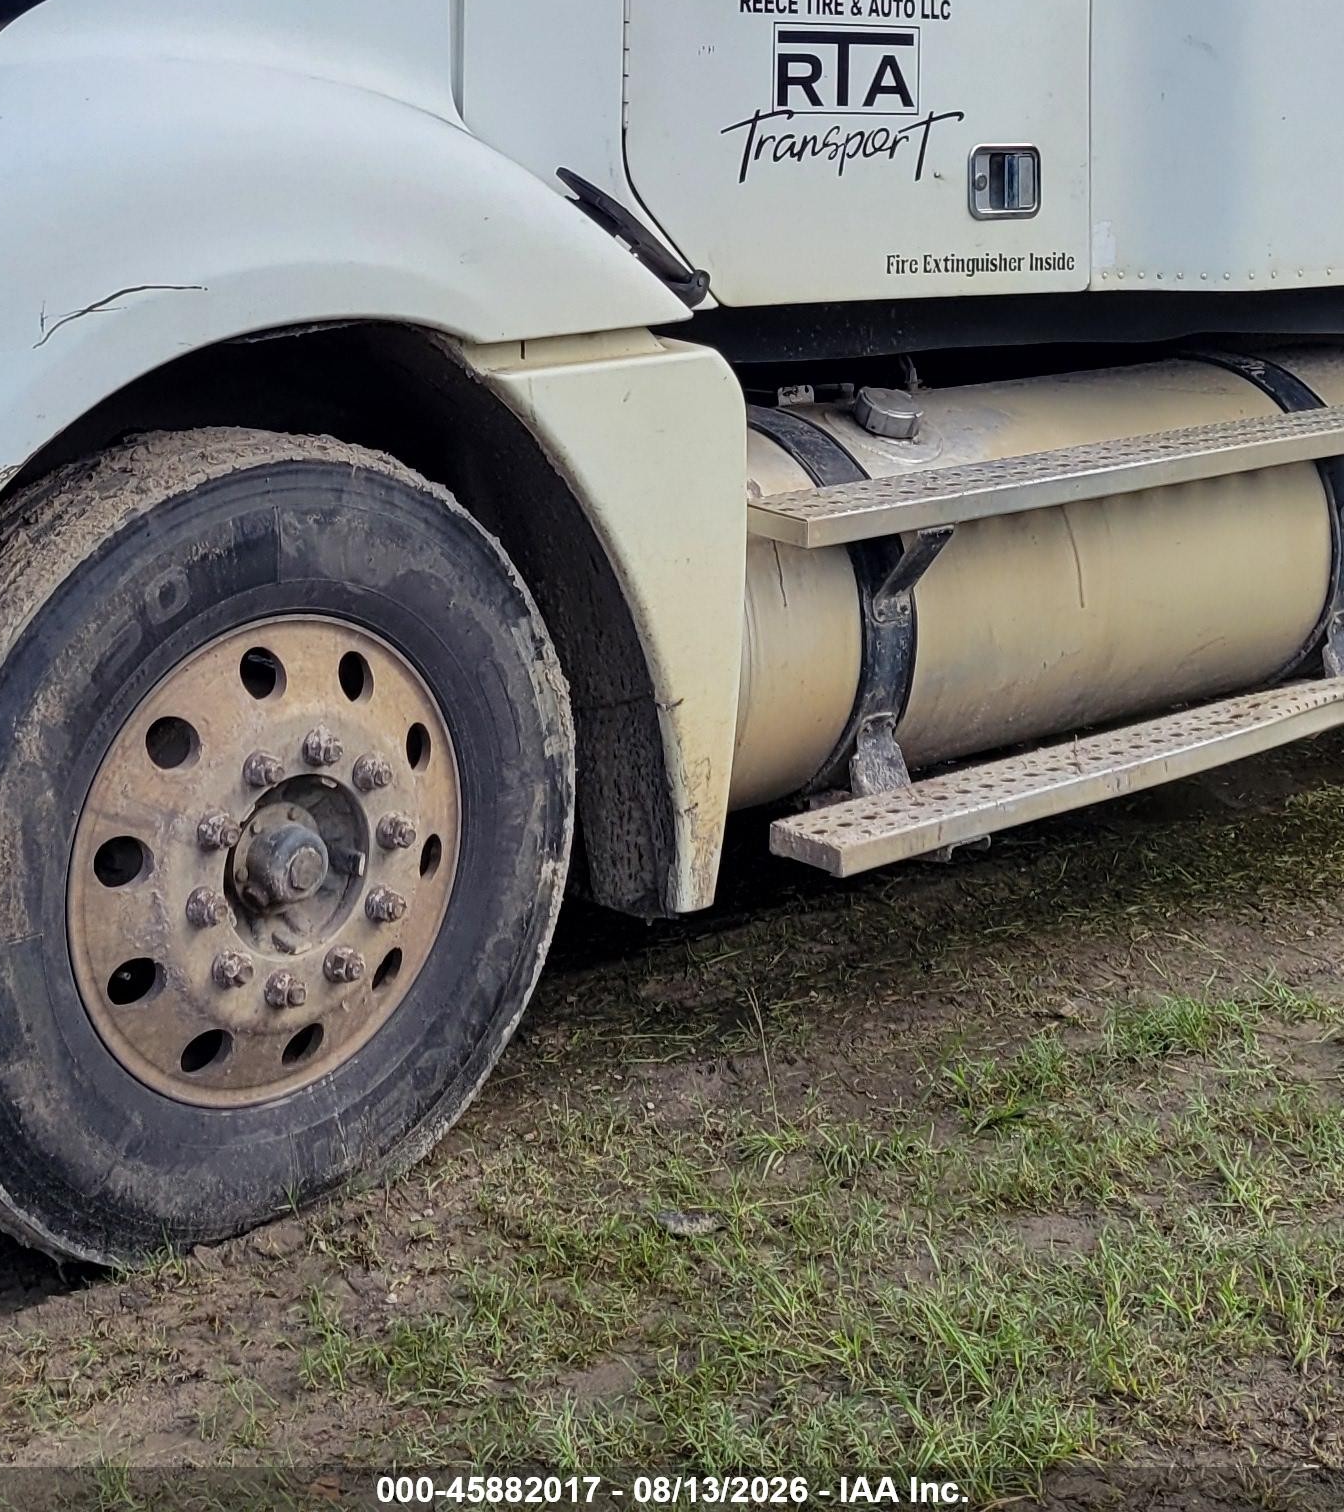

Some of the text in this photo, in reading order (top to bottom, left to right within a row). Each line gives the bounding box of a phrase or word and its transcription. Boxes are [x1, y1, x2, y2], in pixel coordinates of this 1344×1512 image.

[776, 30, 916, 108] RTA
[885, 252, 1075, 277] Fire Extinguisher Inside
